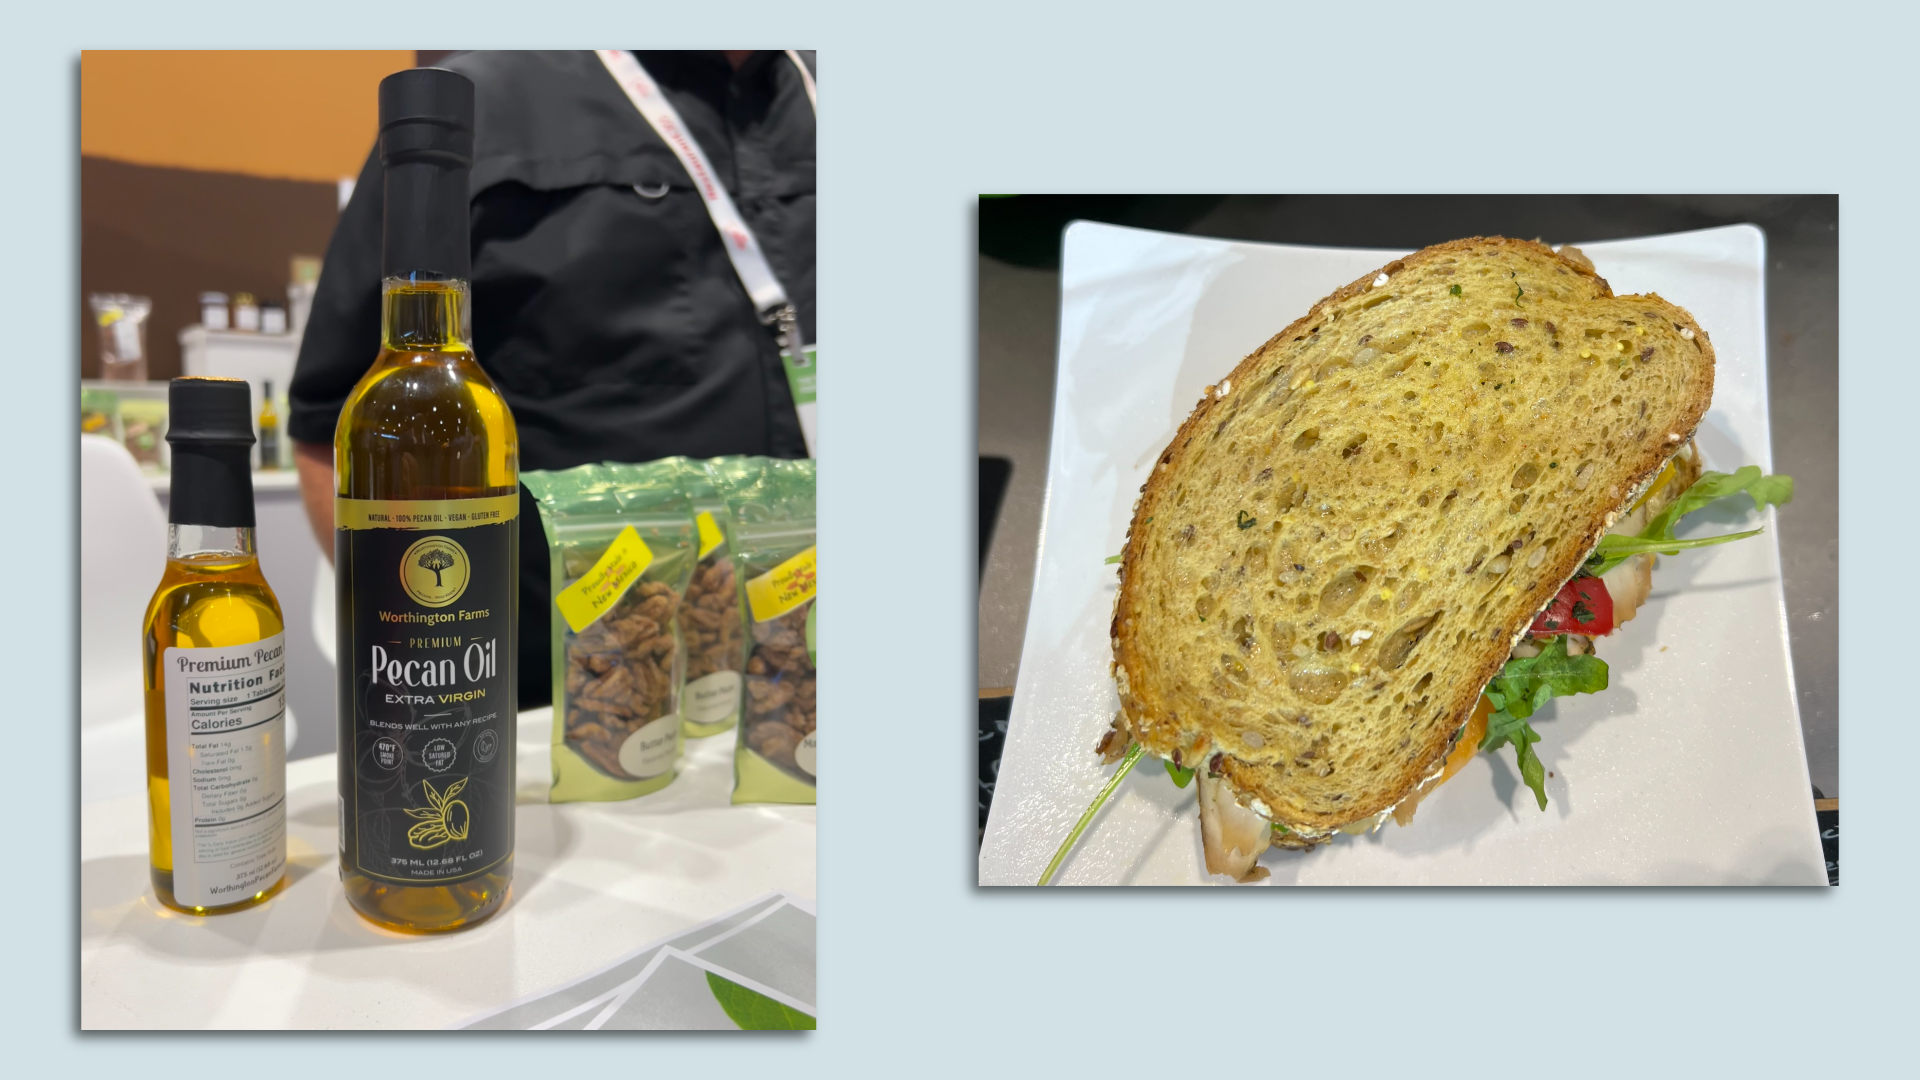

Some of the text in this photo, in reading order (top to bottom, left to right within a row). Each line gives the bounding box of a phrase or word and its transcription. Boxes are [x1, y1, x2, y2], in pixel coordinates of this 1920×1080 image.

[396, 514, 411, 522] 100%
[413, 514, 432, 522] PECAN
[434, 514, 443, 522] OIL
[448, 513, 466, 521] VEGAN
[471, 512, 489, 520] GLUTEN
[490, 510, 500, 518] FREE
[591, 560, 637, 609] New Mexico
[379, 608, 490, 626] Worthington Farms
[410, 636, 462, 648] PREMIUM
[177, 656, 252, 672] Premium
[254, 645, 282, 664] Pecan
[372, 638, 496, 687] Pecan Oil
[190, 676, 263, 694] Nutrition
[190, 698, 220, 706] Serving
[385, 688, 486, 704] EXTRA VIRGIN
[230, 706, 252, 715] Serving
[191, 717, 242, 730] Calories
[370, 719, 403, 730] BLENDS
[430, 722, 452, 730] WITH
[454, 720, 472, 728] ANY
[429, 752, 450, 760] SATURED
[210, 778, 251, 790] Carbohydrate
[410, 858, 425, 866] ML
[427, 857, 454, 867] (12.68
[469, 849, 483, 859] OZ)
[236, 872, 248, 880] 375
[446, 866, 462, 874] USA
